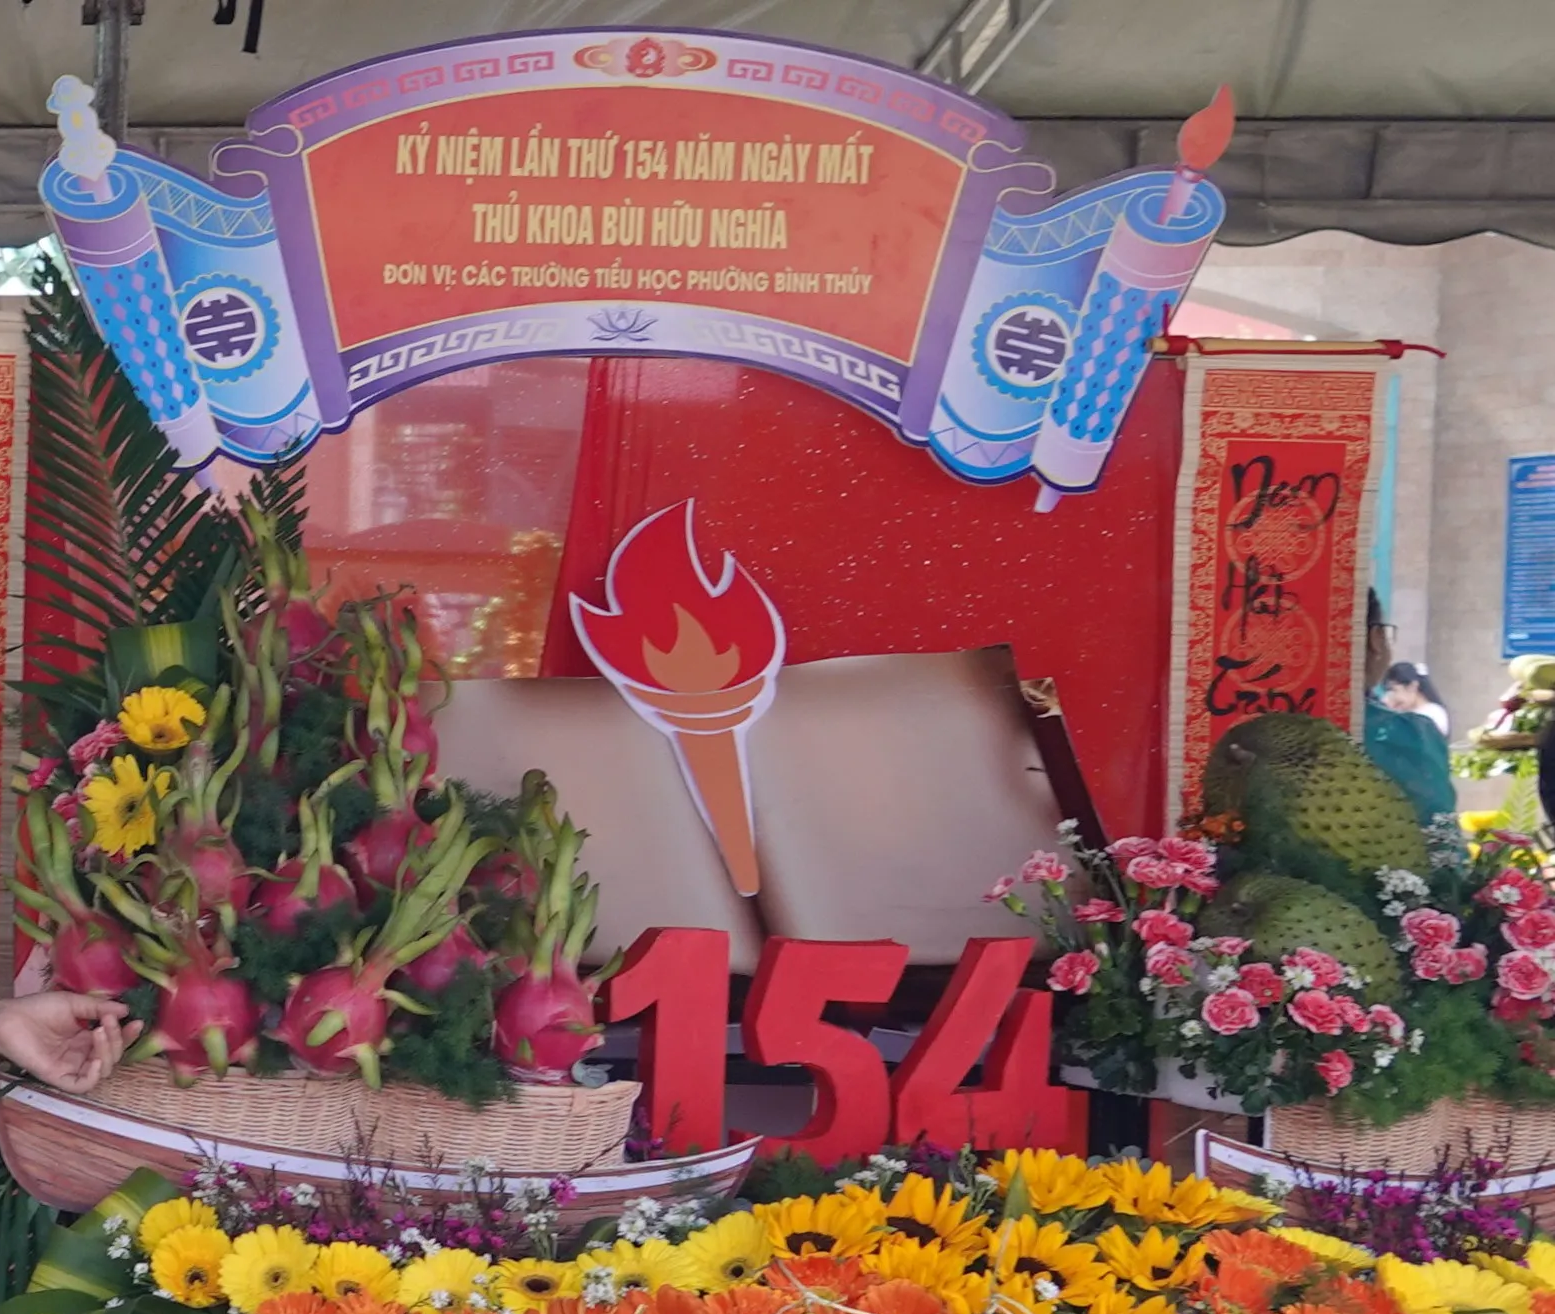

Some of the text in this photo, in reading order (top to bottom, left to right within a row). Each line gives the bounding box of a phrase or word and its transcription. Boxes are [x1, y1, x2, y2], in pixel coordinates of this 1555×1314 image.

[396, 121, 431, 175] KỶ
[436, 127, 505, 186] NIỆM
[567, 130, 620, 179] THỨ
[623, 140, 668, 180] 154
[674, 132, 736, 182] NĂM
[741, 134, 812, 184] NGÀY
[816, 130, 875, 185] MẤT
[472, 190, 787, 249] THỦ KHOA BÙI HỮU NGHĨA
[383, 262, 427, 286] ĐƠN
[461, 260, 507, 287] CÁC
[511, 261, 590, 288] TRƯỜNG
[594, 256, 633, 290] TIỂU
[637, 268, 681, 296] HỌC
[686, 265, 769, 293] PHƯỜNG
[773, 266, 820, 294] BÌNH
[594, 926, 1088, 1168] 154
